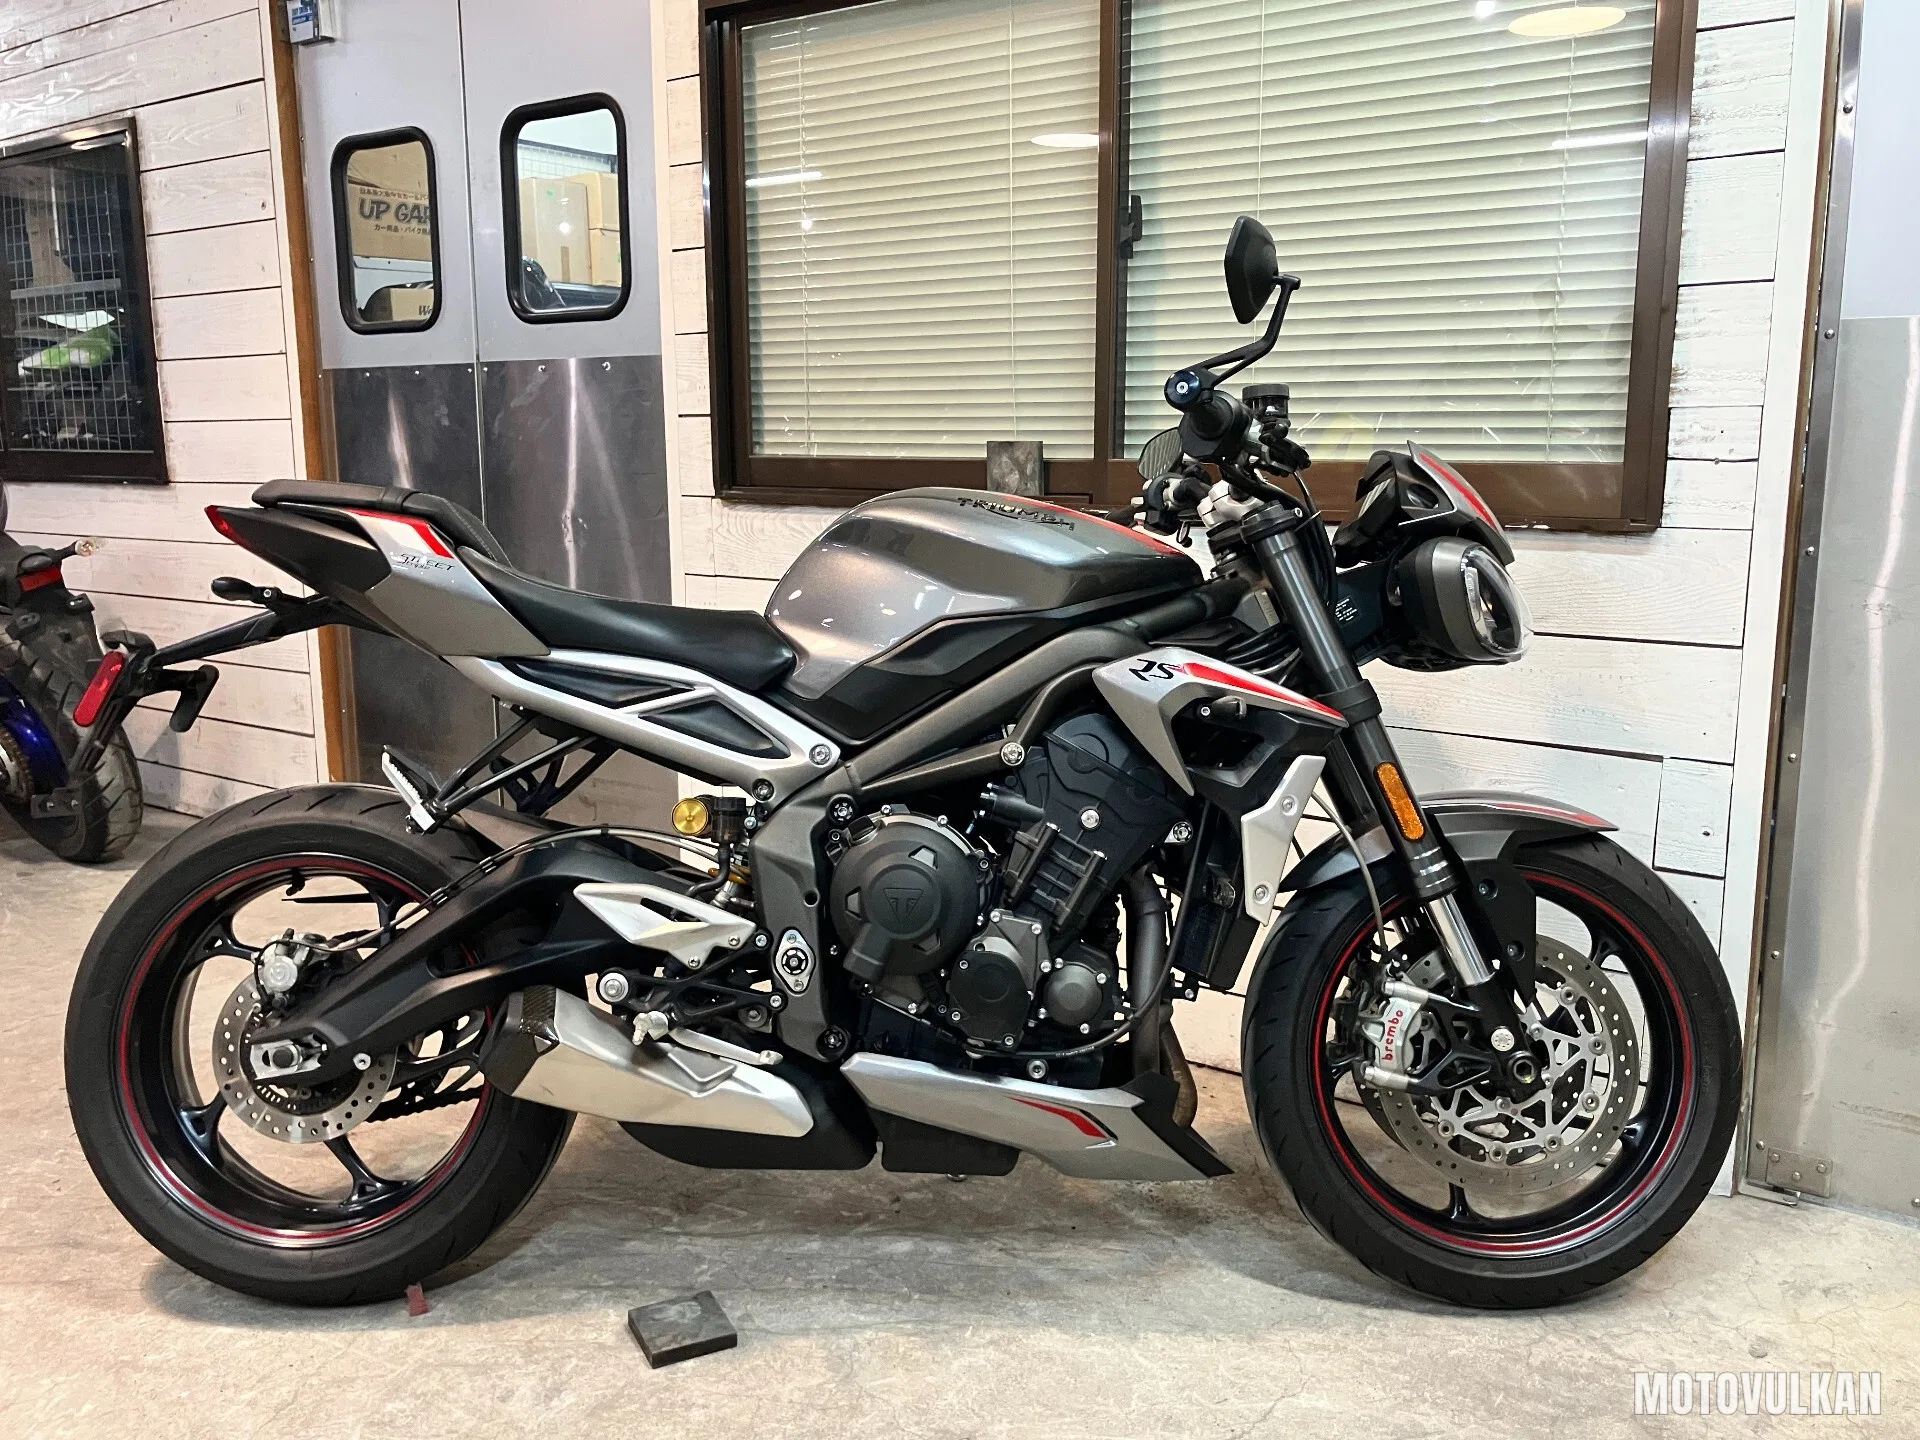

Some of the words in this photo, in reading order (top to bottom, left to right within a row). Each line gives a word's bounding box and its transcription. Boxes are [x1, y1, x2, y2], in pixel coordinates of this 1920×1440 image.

[359, 197, 391, 220] UP
[1128, 658, 1181, 682] RS
[1381, 1009, 1404, 1061] brembo
